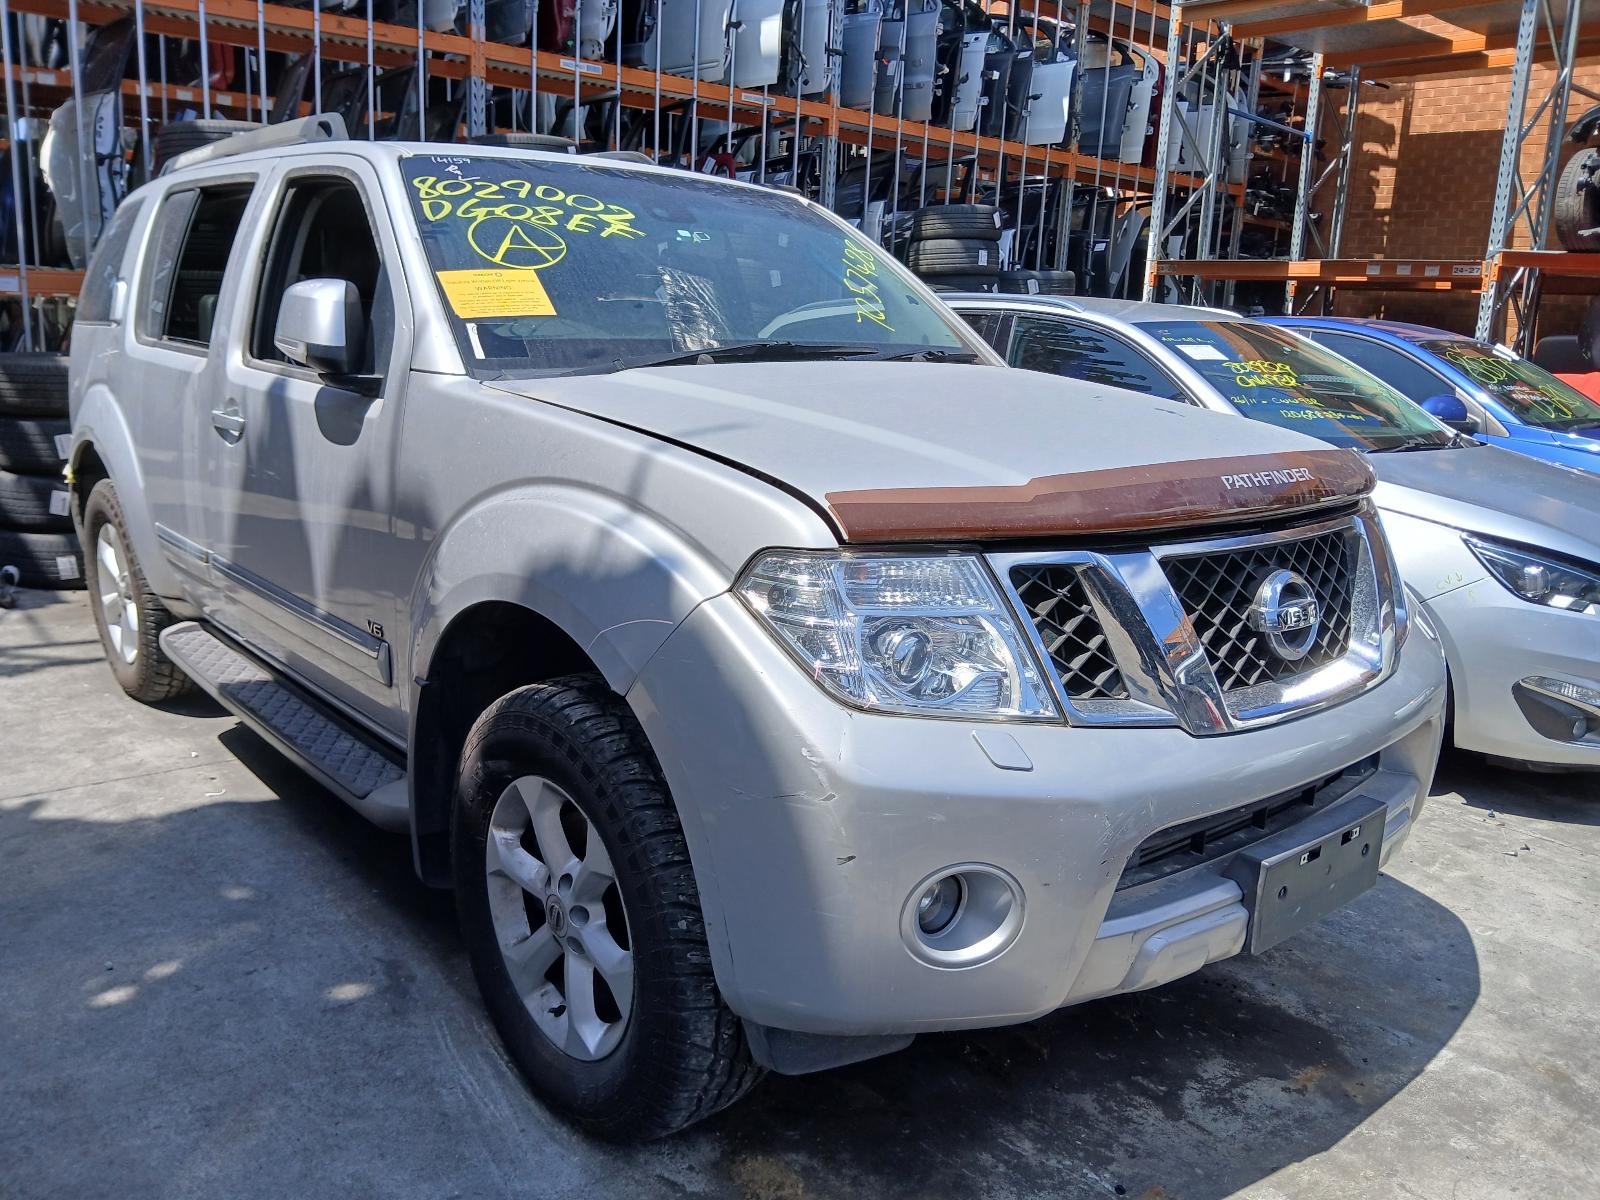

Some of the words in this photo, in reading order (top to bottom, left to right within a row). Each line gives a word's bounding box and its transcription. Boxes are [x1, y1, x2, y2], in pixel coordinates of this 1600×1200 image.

[412, 176, 636, 227] 8029002
[1221, 467, 1315, 489] PATHFINDER
[366, 619, 384, 637] V6
